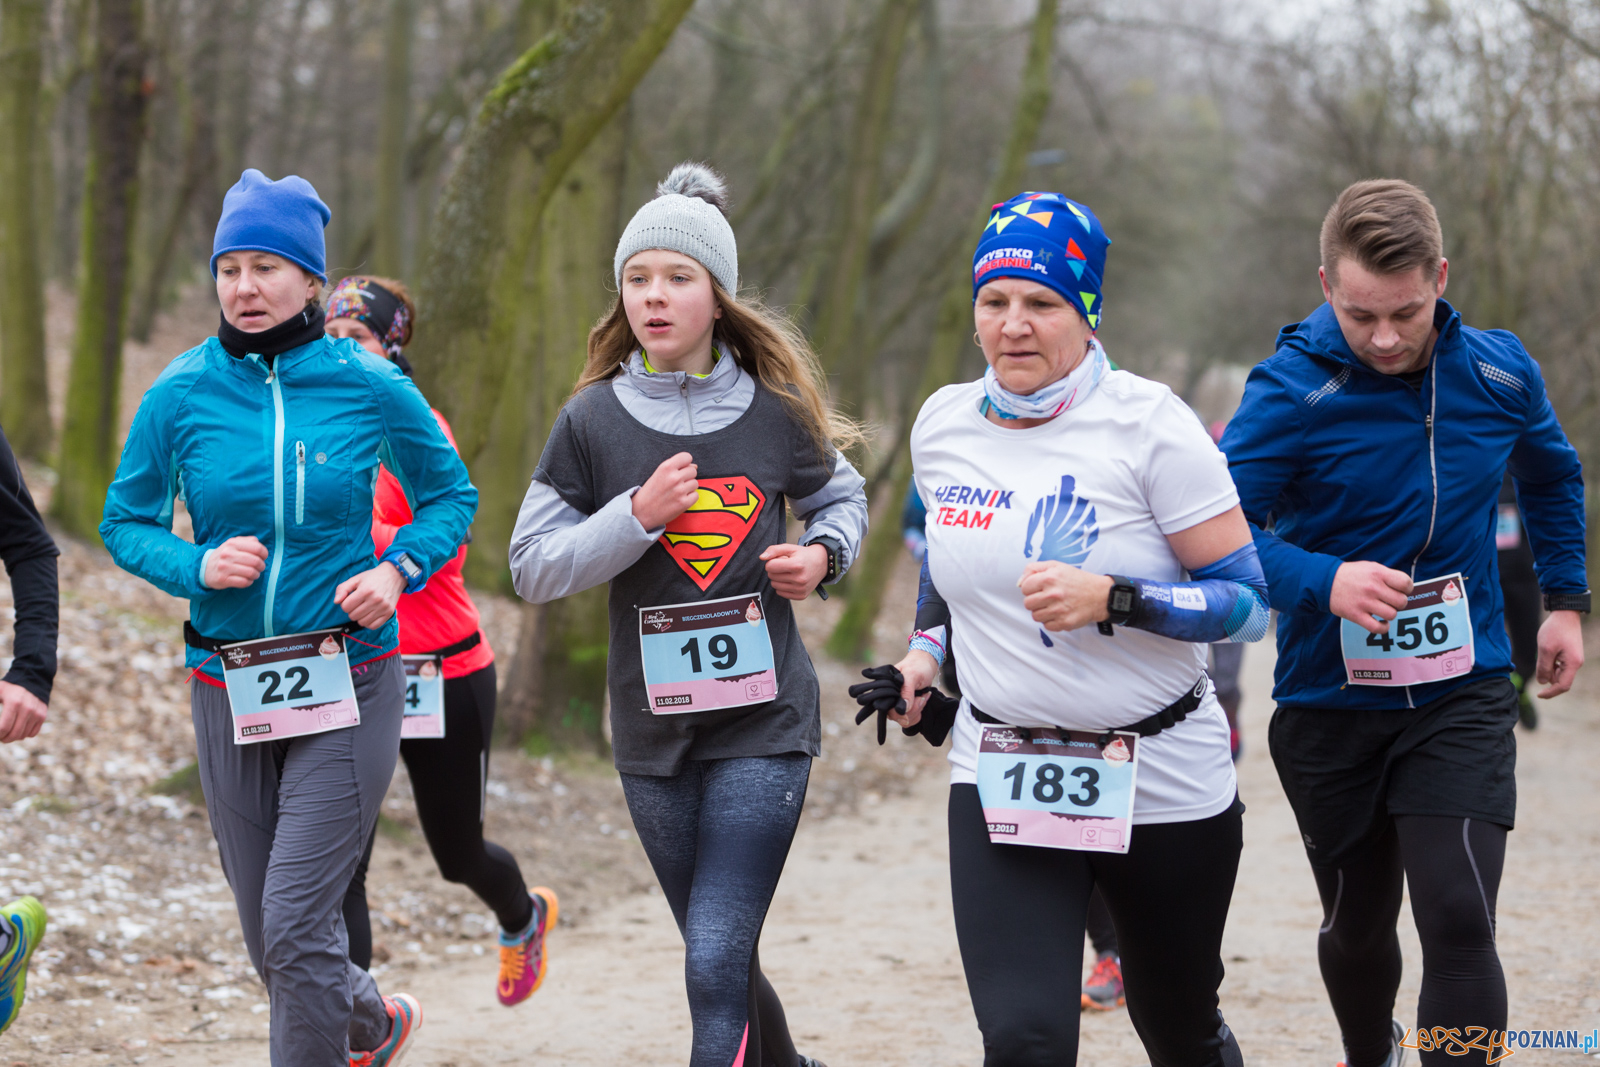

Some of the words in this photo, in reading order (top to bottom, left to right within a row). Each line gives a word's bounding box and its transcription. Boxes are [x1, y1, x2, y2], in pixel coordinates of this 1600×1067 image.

[936, 506, 994, 530] TEAM
[682, 609, 740, 622] BIEGCZEKOLADOWY.PL
[1366, 611, 1449, 652] 456
[680, 634, 738, 673] 19
[257, 665, 313, 705] 22
[1355, 671, 1389, 679] 11.02.2018
[656, 696, 690, 706] 11.02.2018
[243, 725, 270, 735] 11.02.2018
[1003, 762, 1100, 807] 183
